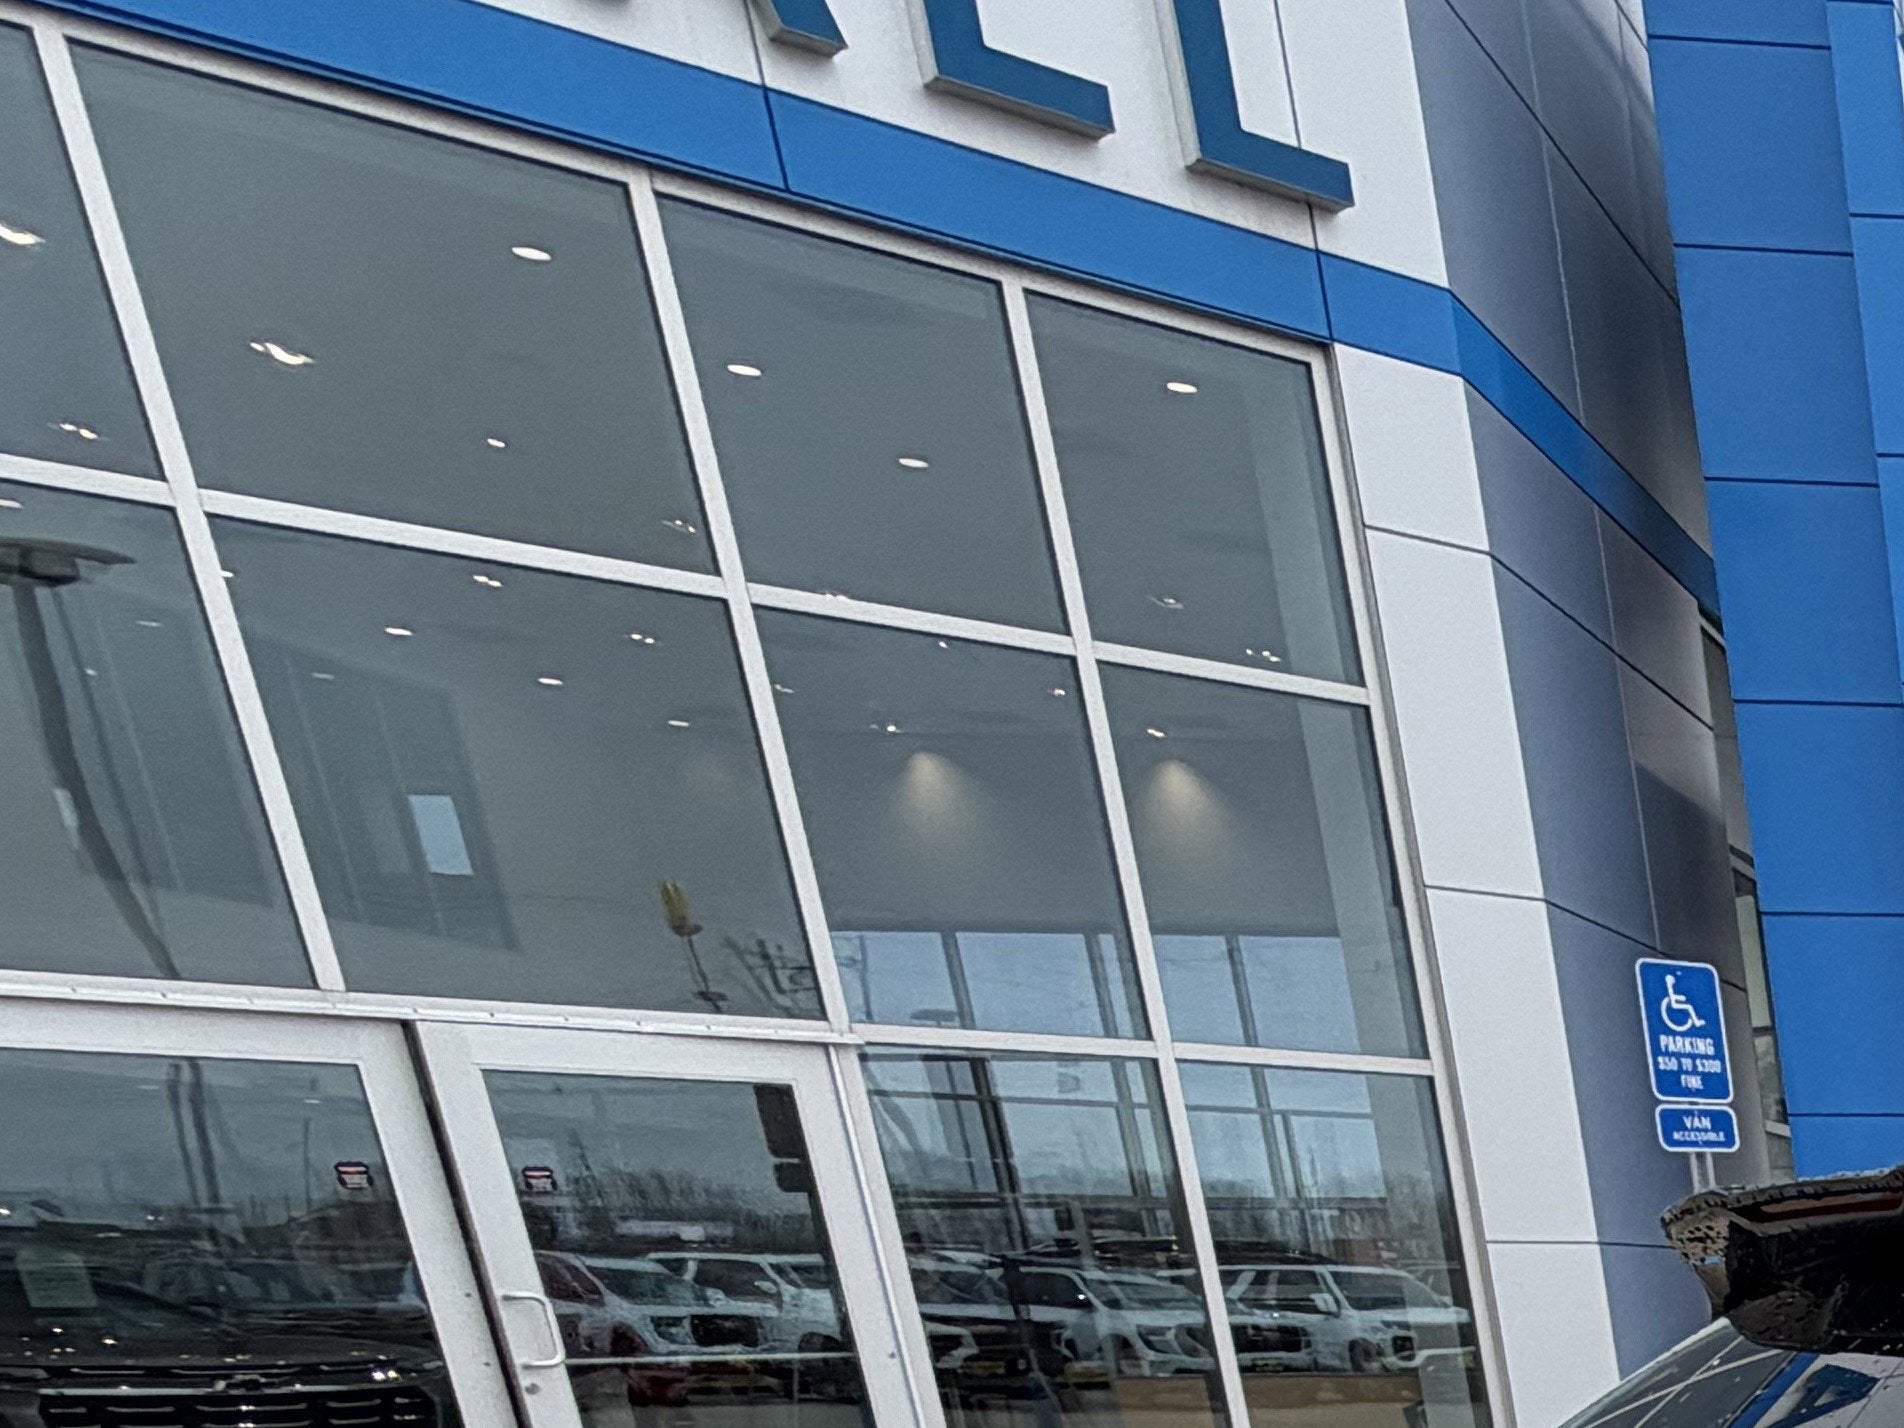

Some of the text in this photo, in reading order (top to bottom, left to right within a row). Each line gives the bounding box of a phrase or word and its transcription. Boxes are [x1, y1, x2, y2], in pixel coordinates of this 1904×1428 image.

[1660, 1035, 1715, 1056] PARKING
[1680, 1057, 1692, 1071] TO
[1682, 1116, 1711, 1130] VAN
